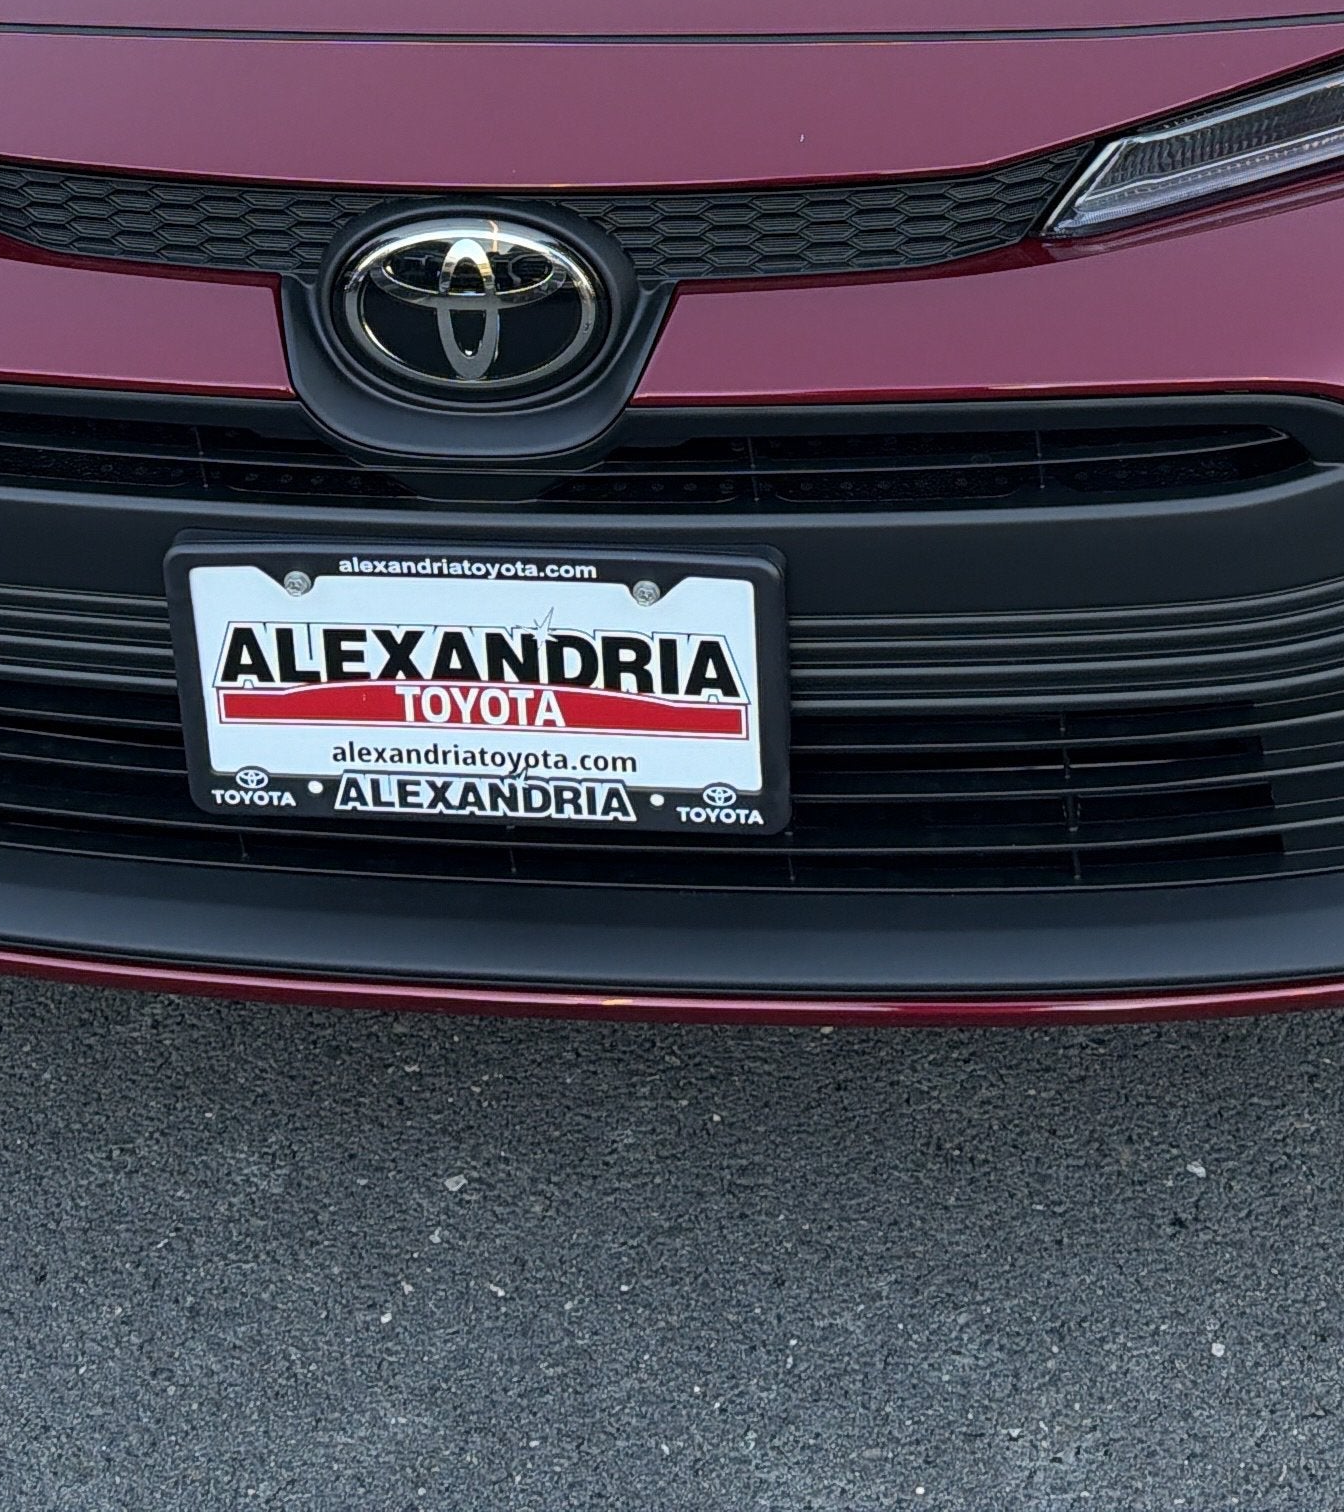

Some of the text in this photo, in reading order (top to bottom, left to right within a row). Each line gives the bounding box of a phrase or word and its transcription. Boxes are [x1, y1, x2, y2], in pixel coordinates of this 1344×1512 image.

[339, 557, 597, 580] alexandriatoyota.com
[218, 626, 743, 699] ALEXANDRIA
[395, 685, 565, 727] TOYOTA
[331, 741, 637, 775] alexandriatoyota.com
[212, 773, 765, 826] TOYOTA ALEXANDRIA TOYOTA
